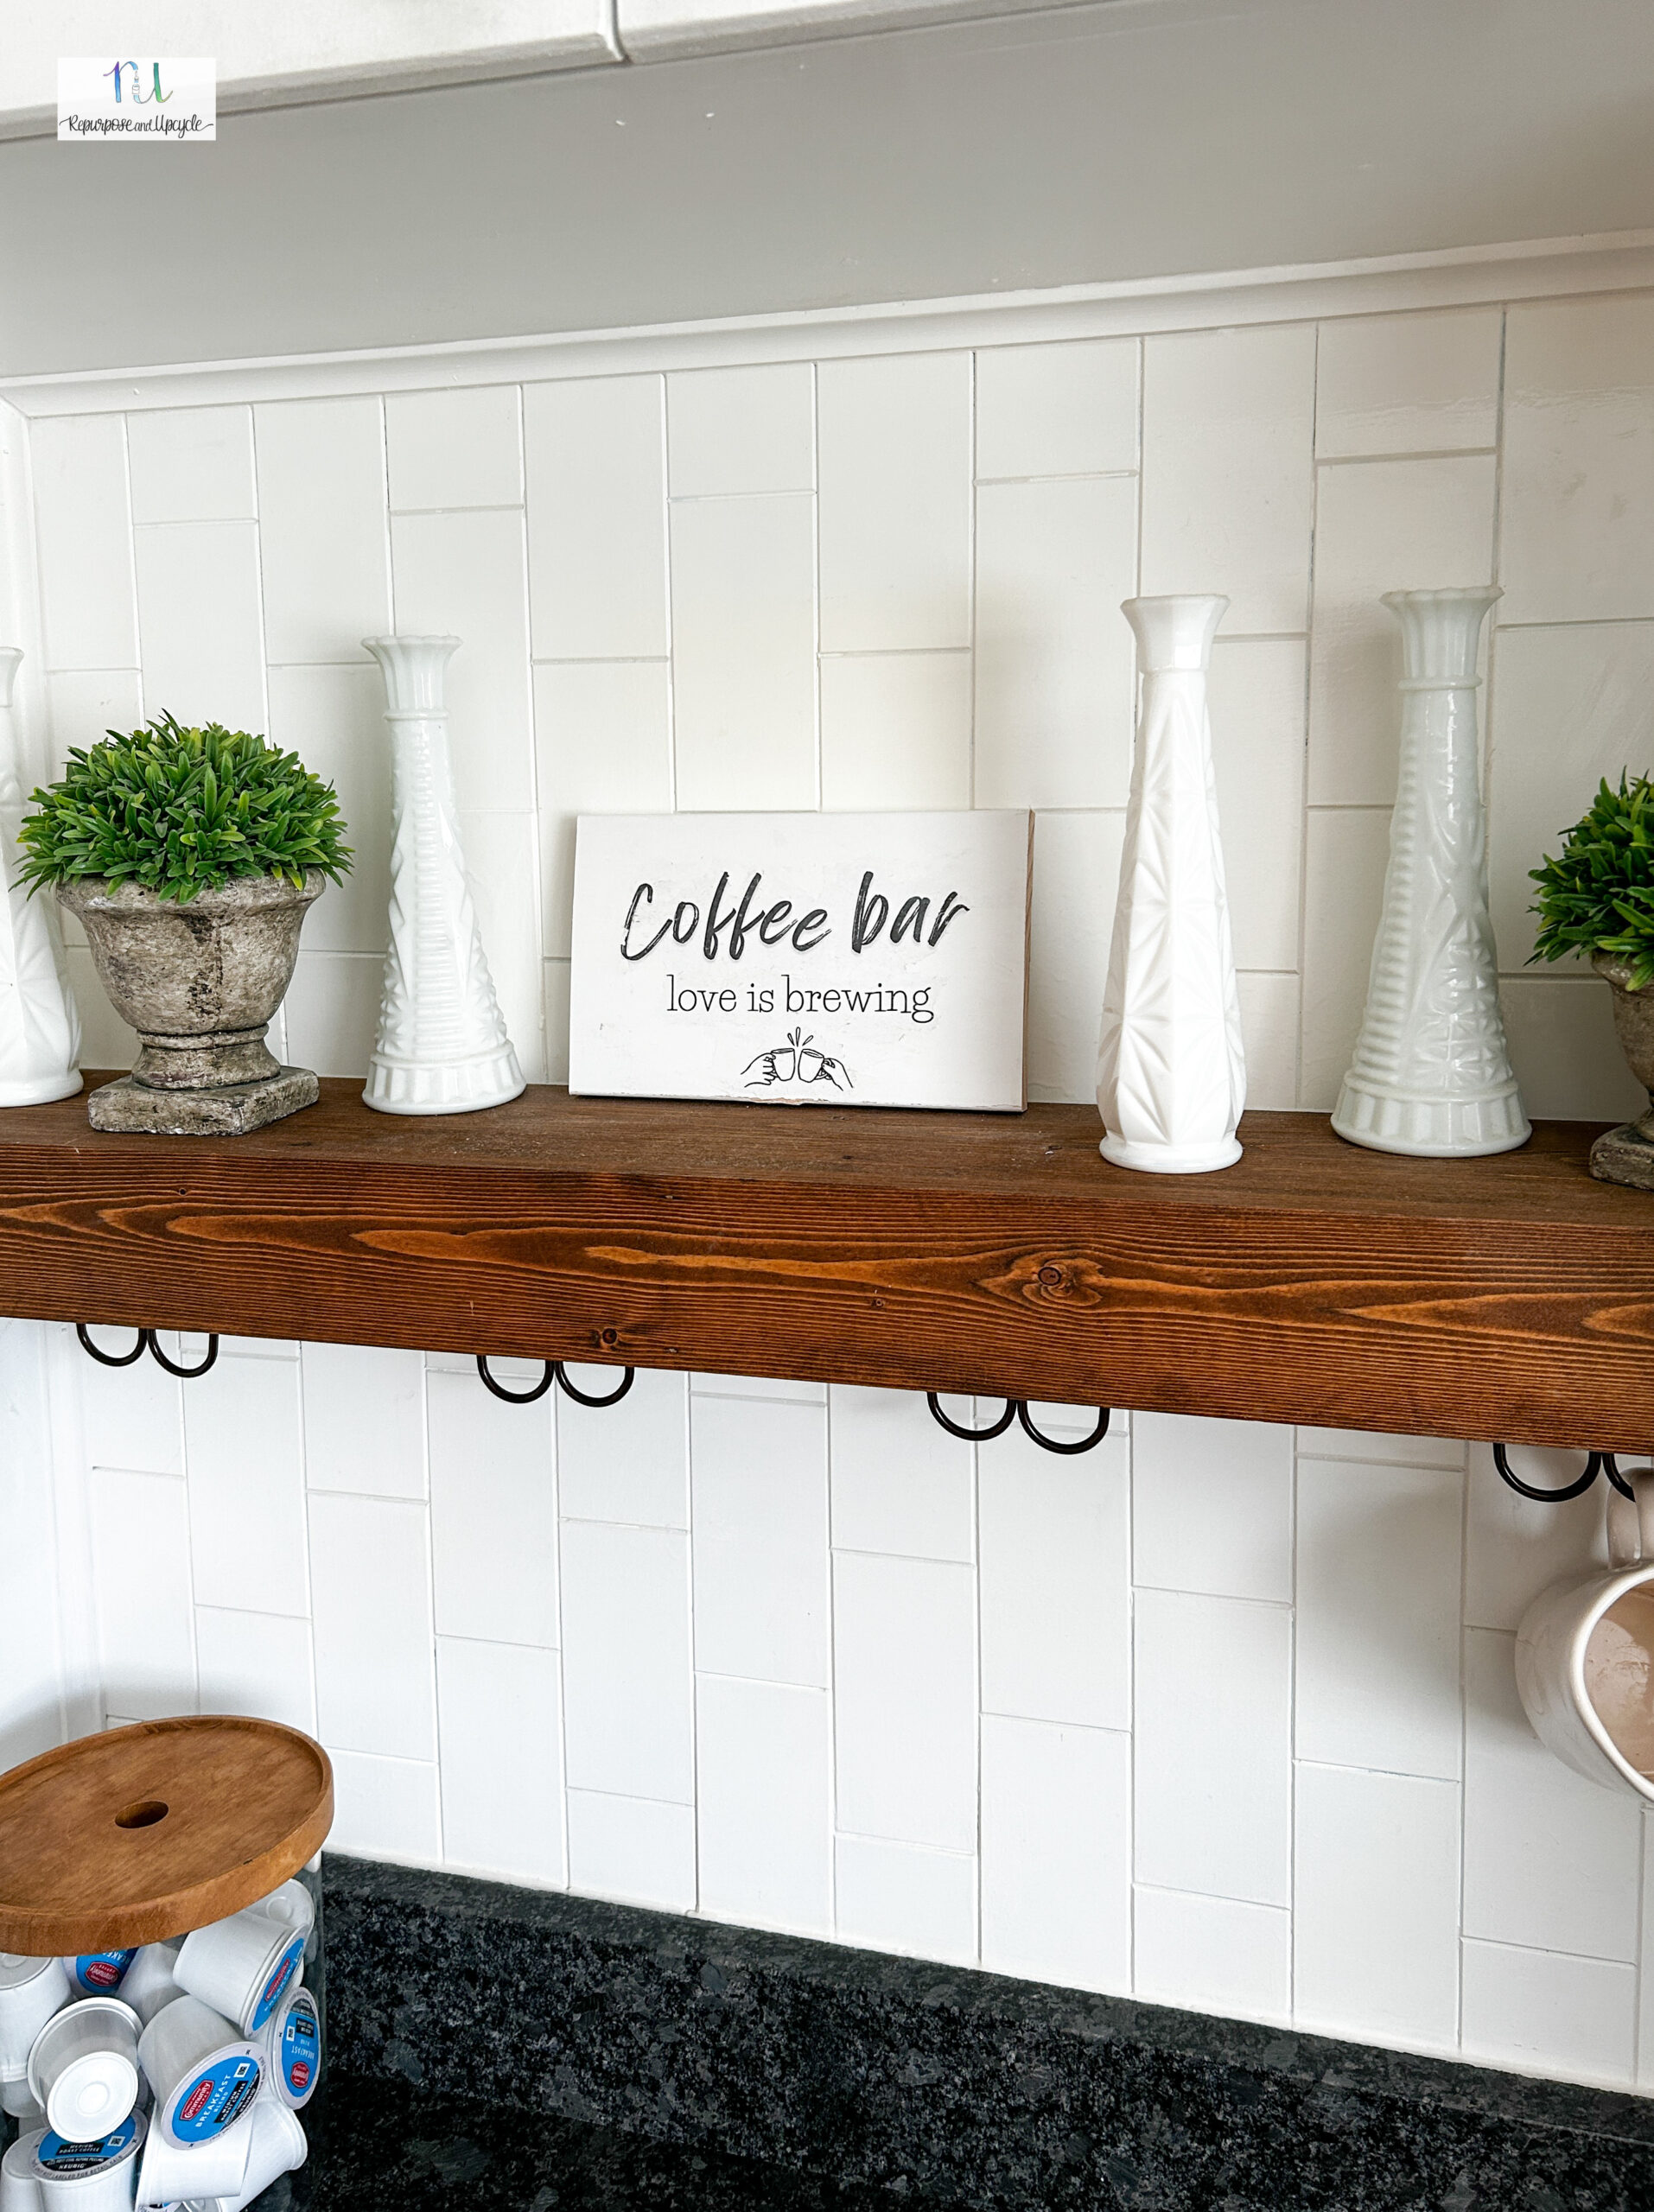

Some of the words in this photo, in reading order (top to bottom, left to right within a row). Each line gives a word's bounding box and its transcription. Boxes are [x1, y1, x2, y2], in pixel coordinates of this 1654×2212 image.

[620, 871, 832, 961] Coffee
[850, 870, 970, 954] bar
[665, 974, 737, 1013] love
[747, 982, 774, 1013] is
[780, 974, 935, 1024] brewing
[194, 2074, 231, 2127] BREAKFAST
